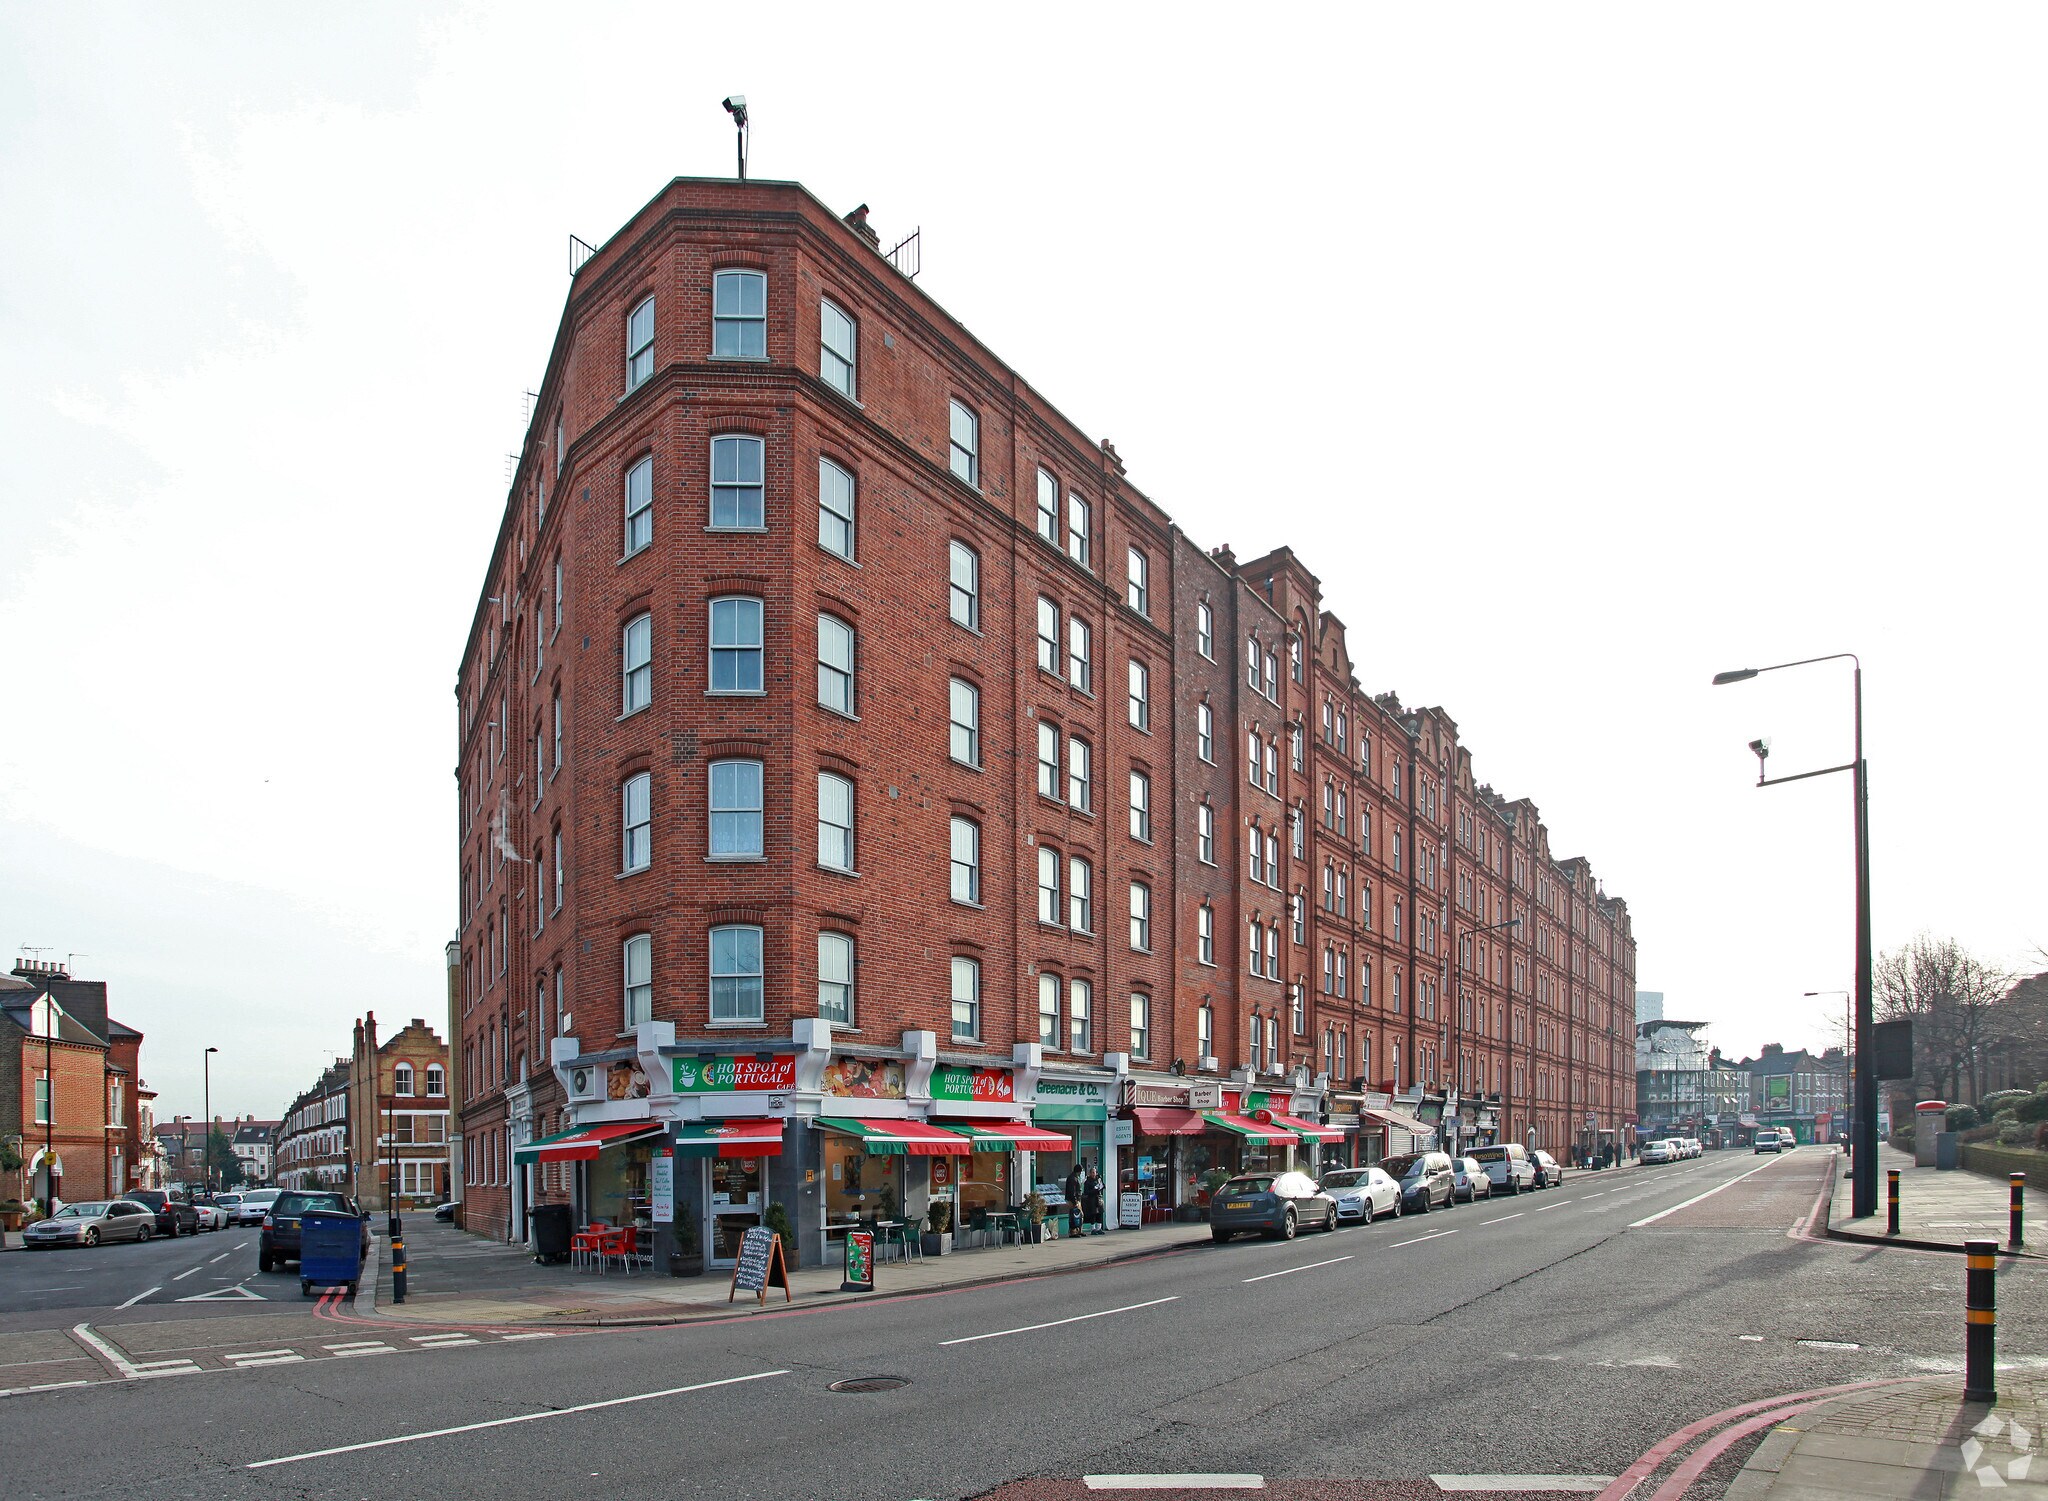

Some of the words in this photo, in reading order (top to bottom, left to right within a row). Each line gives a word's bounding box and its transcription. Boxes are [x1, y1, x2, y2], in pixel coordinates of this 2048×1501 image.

[717, 1062, 744, 1073] HOT
[746, 1062, 778, 1073] SPOT
[780, 1062, 793, 1074] of
[717, 1072, 784, 1084] PORTUGAL
[945, 1074, 960, 1084] HOT
[961, 1075, 980, 1085] SPOT
[980, 1076, 988, 1088] of
[945, 1084, 983, 1095] PORTUGAL
[1036, 1081, 1078, 1095] Greenacre
[1079, 1082, 1086, 1095] &
[1087, 1083, 1099, 1096] Co.
[1158, 1094, 1173, 1103] Barber
[1173, 1095, 1184, 1104] Shop
[807, 1171, 813, 1180] H
